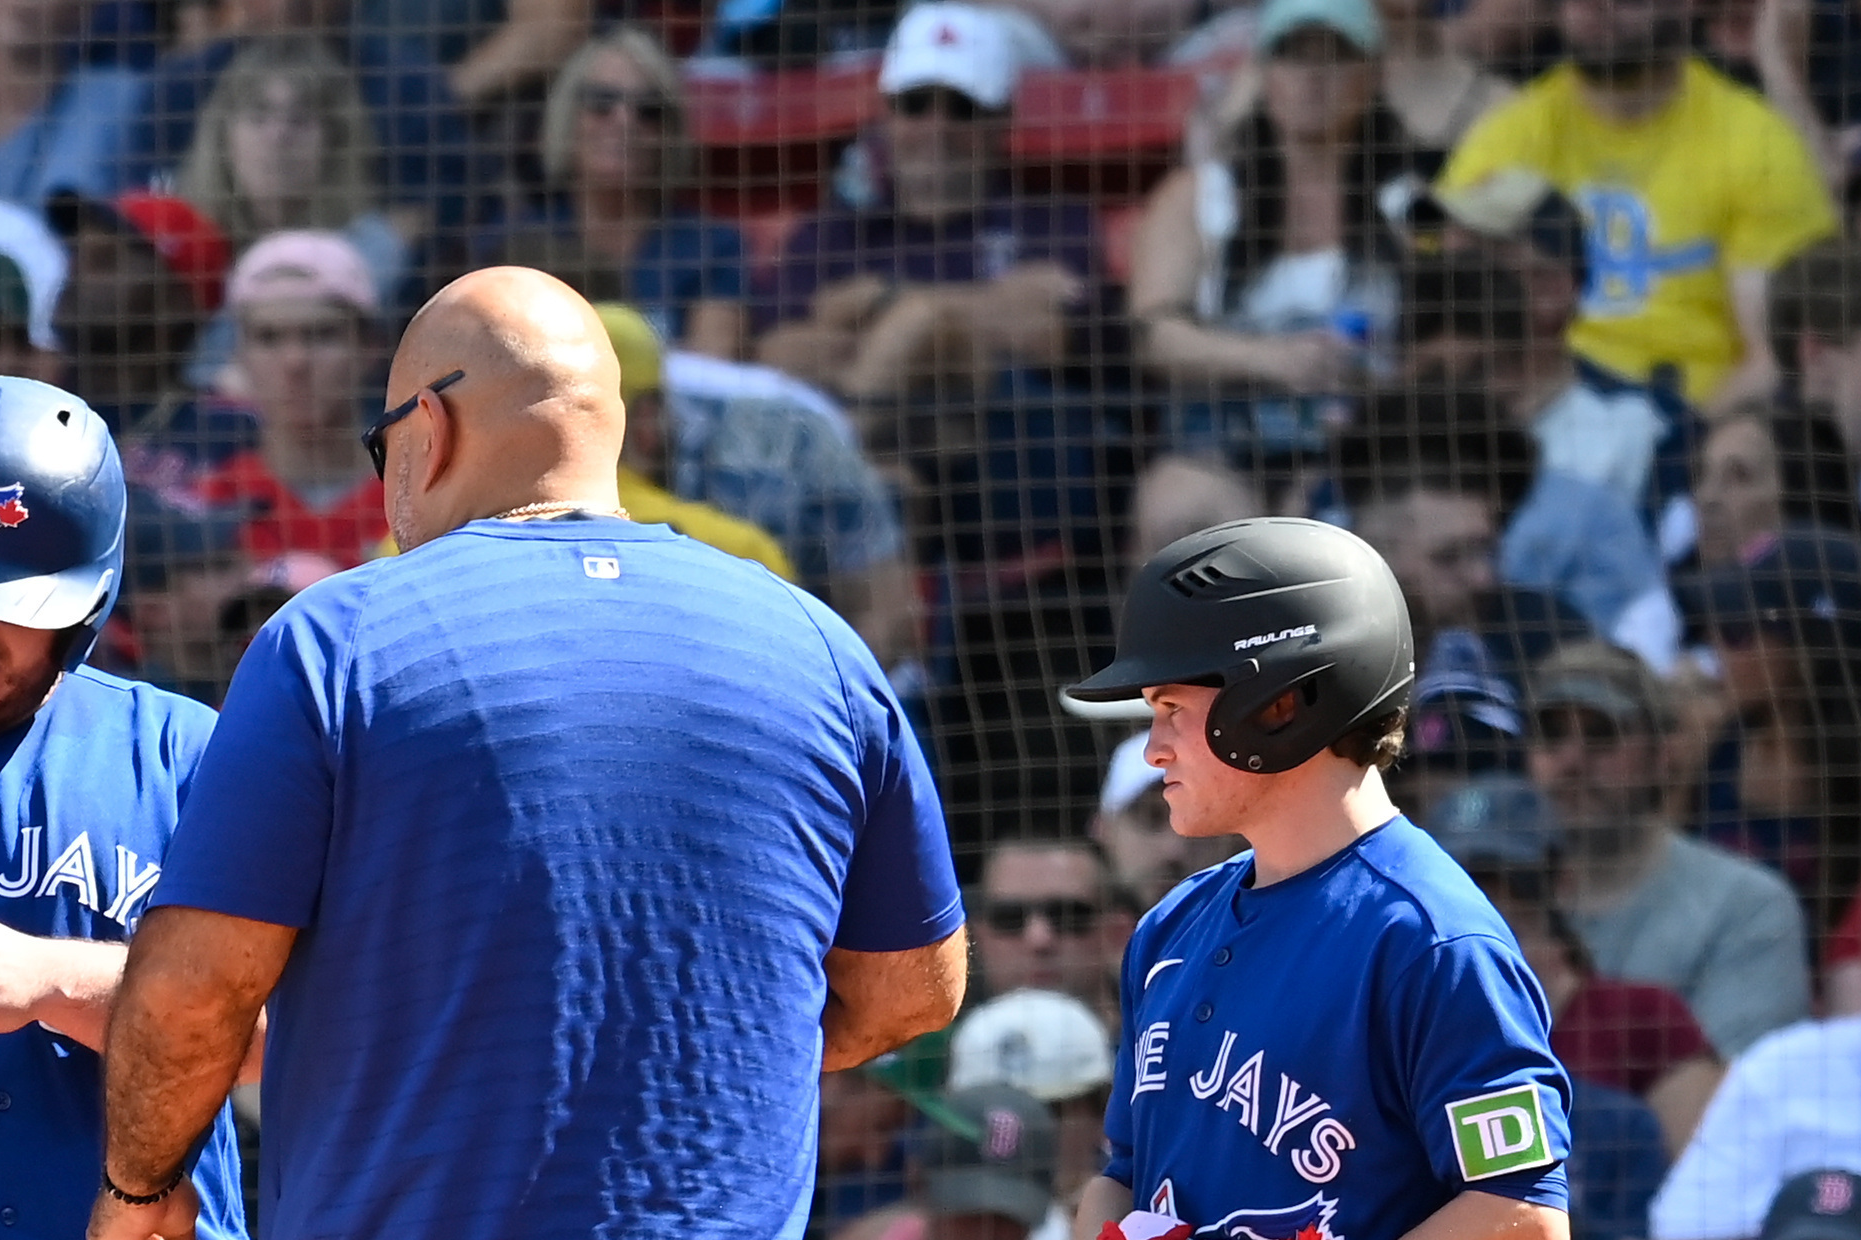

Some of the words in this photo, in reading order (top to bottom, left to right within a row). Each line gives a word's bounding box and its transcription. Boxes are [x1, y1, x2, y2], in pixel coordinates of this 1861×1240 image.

[1233, 624, 1318, 651] RAWLINGS
[1189, 1030, 1356, 1184] JAYS
[1461, 1106, 1535, 1160] TD
